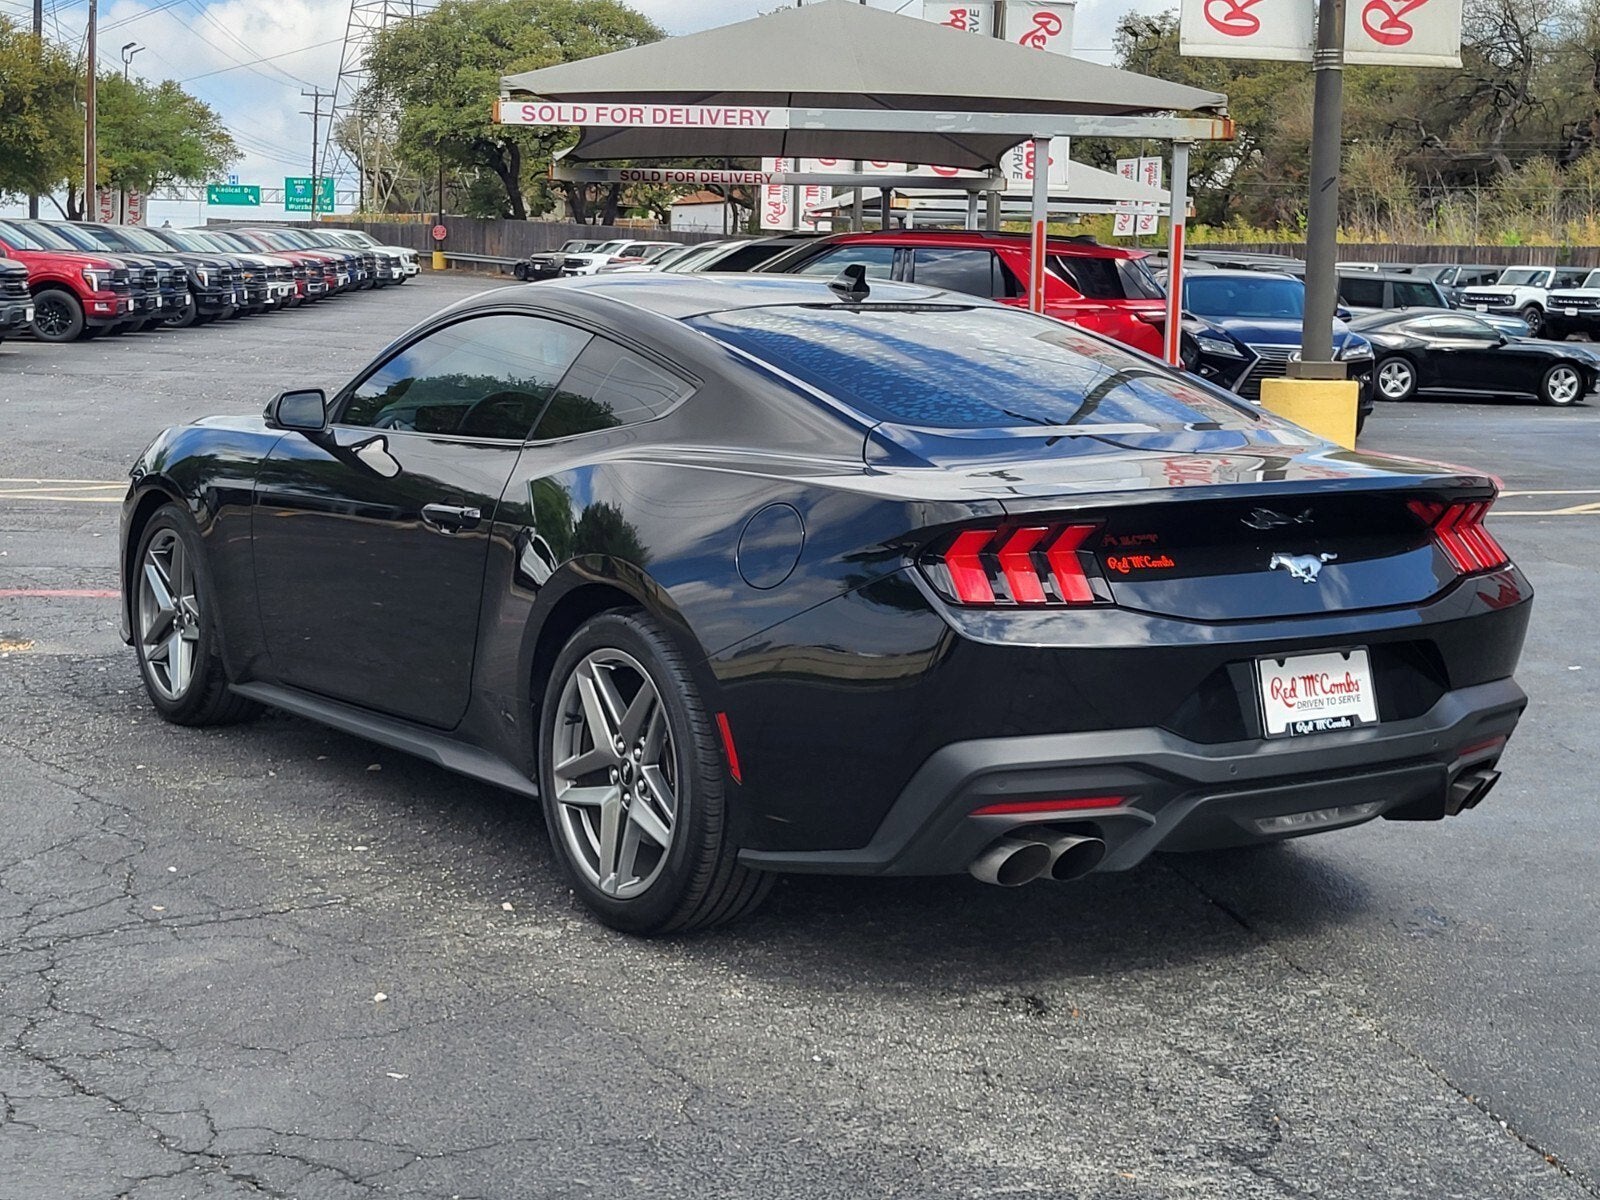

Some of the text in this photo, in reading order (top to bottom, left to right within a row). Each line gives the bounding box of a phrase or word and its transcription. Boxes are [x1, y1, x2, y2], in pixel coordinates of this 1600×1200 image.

[969, 8, 980, 33] RVE
[1019, 12, 1062, 50] Re
[521, 105, 771, 126] SOLD FOR DELIVERY
[1012, 146, 1024, 180] ERVE
[619, 170, 773, 184] SOLD FOR DELIVERY
[766, 201, 786, 224] Red
[1107, 556, 1130, 574] Red
[1270, 671, 1360, 709] Red McCombs
[1297, 694, 1361, 710] DRIVEN TO SERVE
[1296, 716, 1351, 735] Red McCombs
